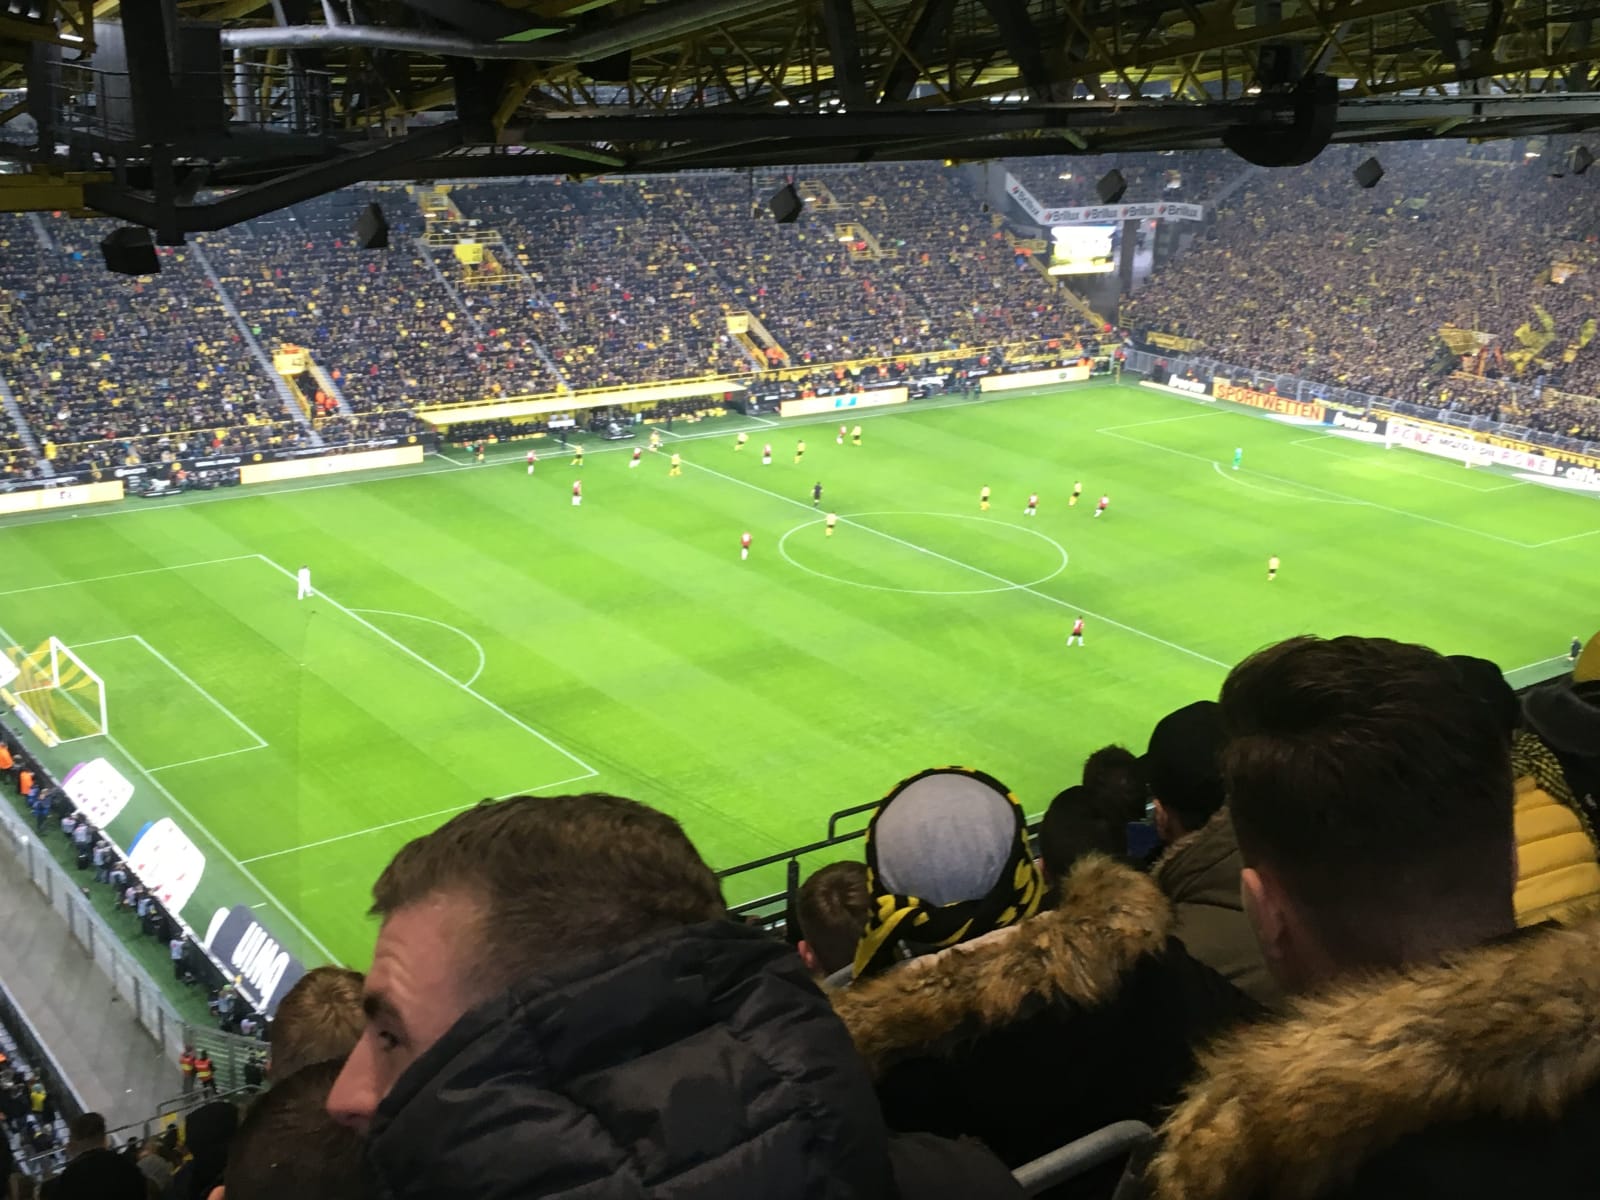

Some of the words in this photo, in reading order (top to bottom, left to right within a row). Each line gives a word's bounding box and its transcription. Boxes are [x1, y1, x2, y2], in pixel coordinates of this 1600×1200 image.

[1052, 209, 1080, 222] Brillux
[1092, 207, 1118, 220] Brillux
[1128, 205, 1155, 218] Brillux
[1167, 203, 1198, 218] Brillux
[1217, 384, 1321, 421] SPORTWETTEN
